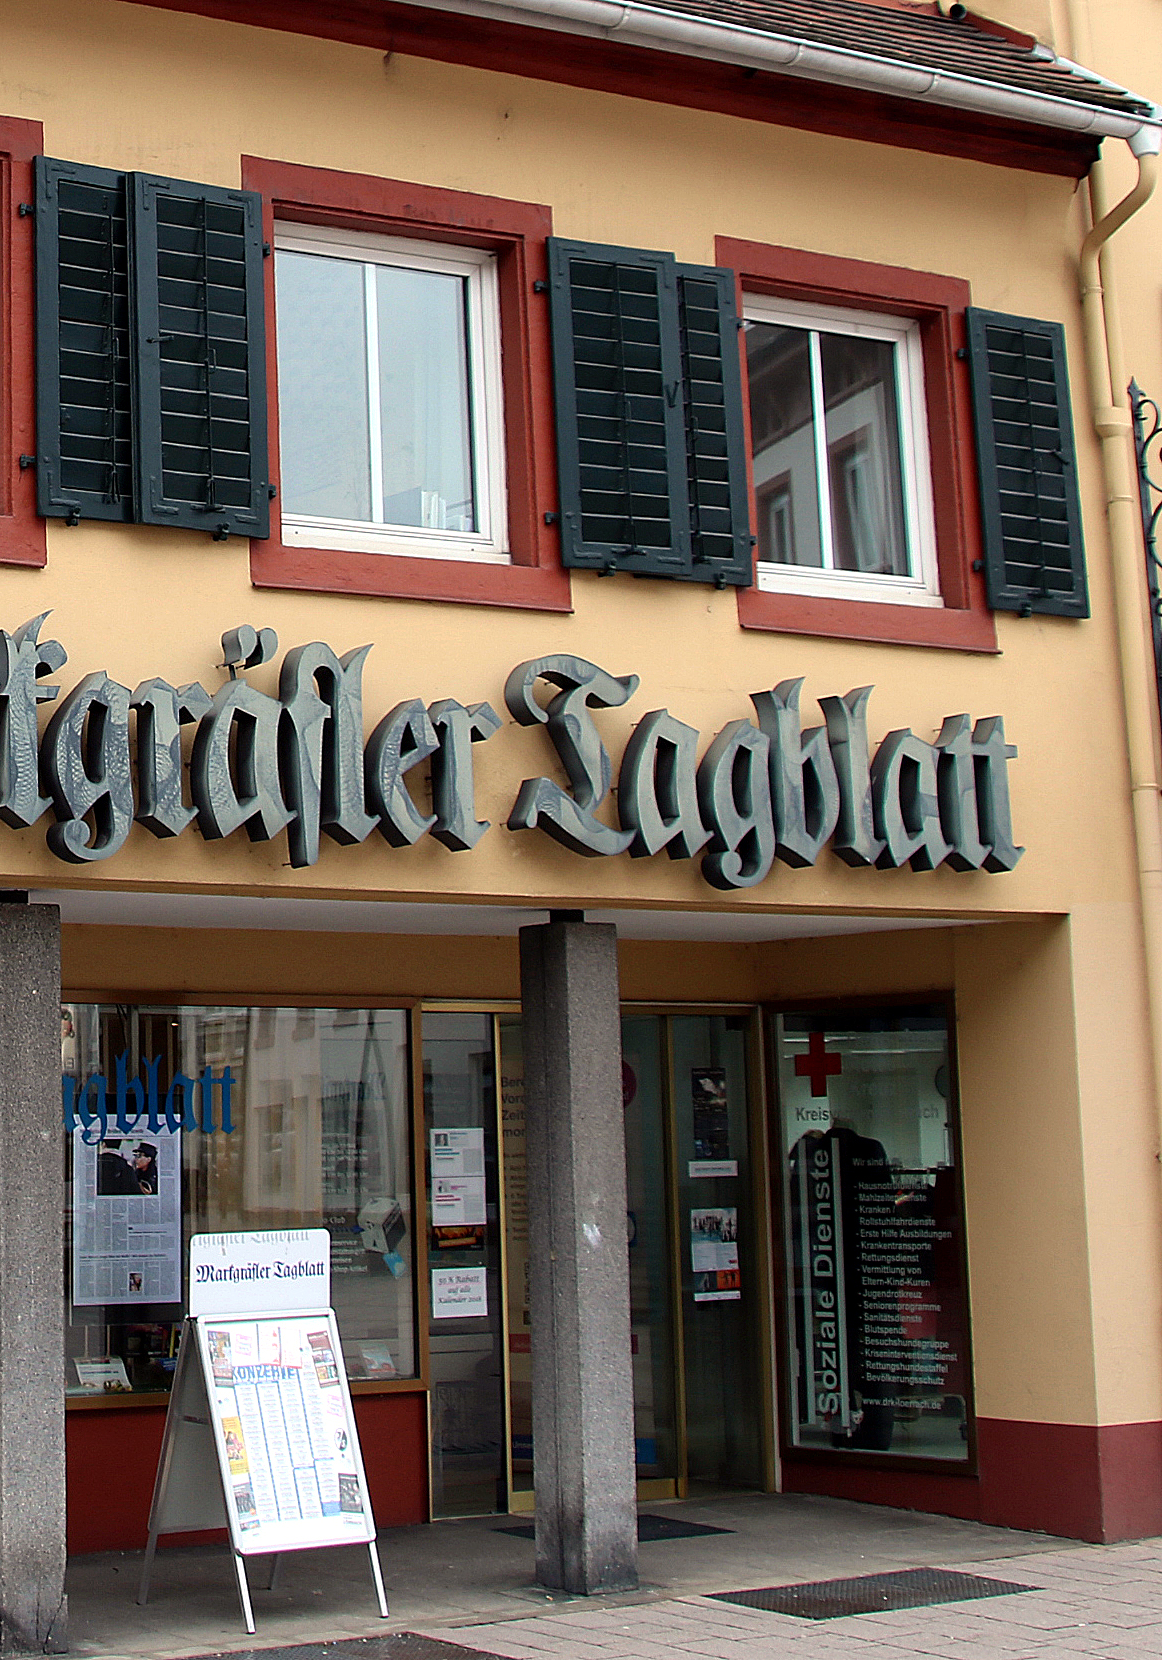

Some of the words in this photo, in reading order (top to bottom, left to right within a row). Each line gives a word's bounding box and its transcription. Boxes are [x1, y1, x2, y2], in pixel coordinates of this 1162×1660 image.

[505, 653, 1025, 891] Tagblatt
[866, 1157, 884, 1167] sind
[811, 1148, 834, 1278] Dienste
[859, 1205, 891, 1213] Kranken
[859, 1217, 936, 1227] Rollstuhlfahrdienste
[860, 1229, 880, 1238] Erste
[881, 1229, 898, 1239] Hilfe
[899, 1230, 952, 1241] Ausbildungen
[861, 1241, 931, 1252] Krankentransporte
[861, 1253, 919, 1264] Rettungsdienst
[195, 1263, 272, 1284] Markgräfler
[273, 1260, 326, 1281] Tagblatt
[862, 1265, 906, 1276] Vermittlung
[907, 1267, 922, 1275] von
[862, 1277, 930, 1287] Eltern-Kind-Kuren
[863, 1289, 923, 1299] Jugendrotkreuz
[863, 1301, 941, 1312] Seniorenprogramme
[863, 1313, 923, 1323] Sanitätsdienste
[864, 1325, 908, 1336] Blutspende
[865, 1337, 949, 1349] Besuchshundegruppe
[817, 1290, 838, 1415] Soziale
[865, 1349, 958, 1362] Kriseninterventionsdienst
[865, 1361, 949, 1373] Rettungshundestaffel
[866, 1372, 946, 1386] Bevölkerungsschutz
[862, 1396, 941, 1410] www.drk-loerrach.de
